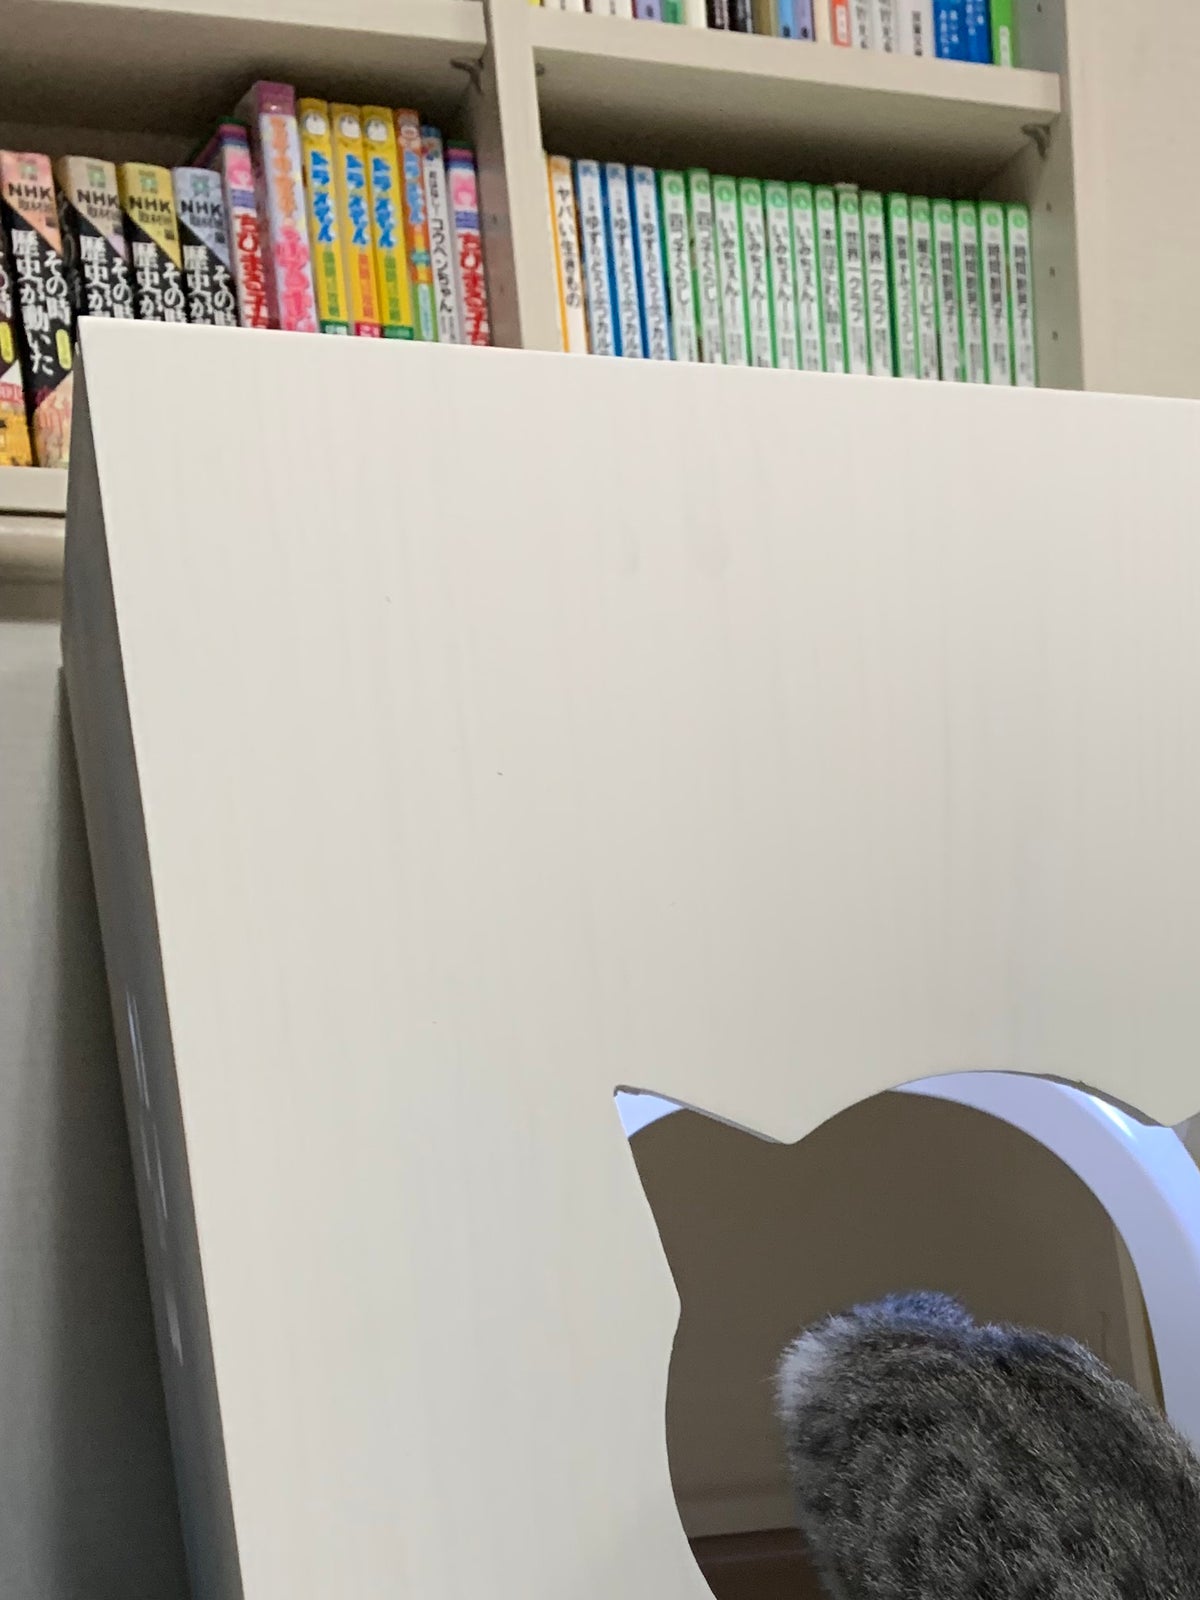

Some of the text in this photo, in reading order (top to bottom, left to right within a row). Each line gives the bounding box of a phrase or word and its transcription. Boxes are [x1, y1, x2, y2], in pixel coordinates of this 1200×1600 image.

[9, 182, 51, 199] NHK
[77, 189, 119, 206] NHK
[129, 196, 171, 212] NHK
[181, 201, 222, 215] NHK
[11, 228, 53, 375] 歴史が動いた
[46, 251, 71, 325] その時
[79, 235, 112, 316] 歴史が
[132, 242, 163, 320] 歴史が
[183, 245, 212, 324] 歴史が
